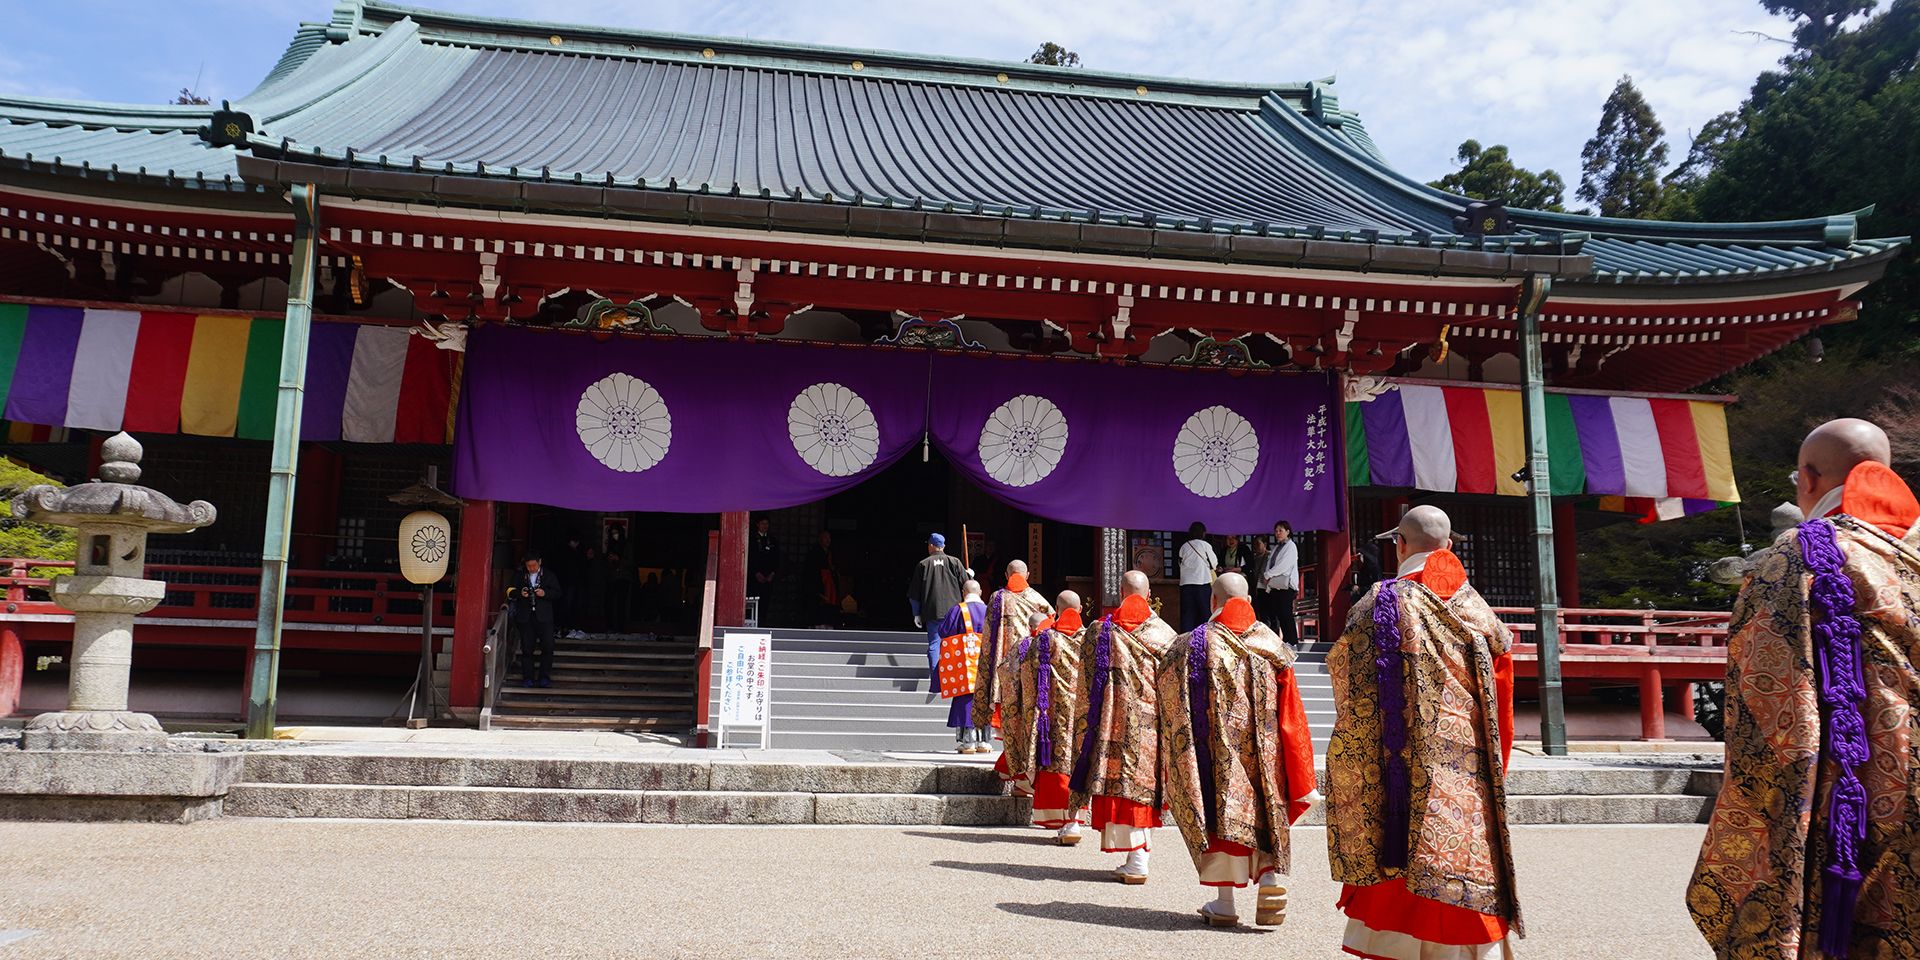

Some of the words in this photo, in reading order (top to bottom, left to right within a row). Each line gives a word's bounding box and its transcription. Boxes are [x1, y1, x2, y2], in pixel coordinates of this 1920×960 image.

[1315, 404, 1327, 474] 平成十九年度
